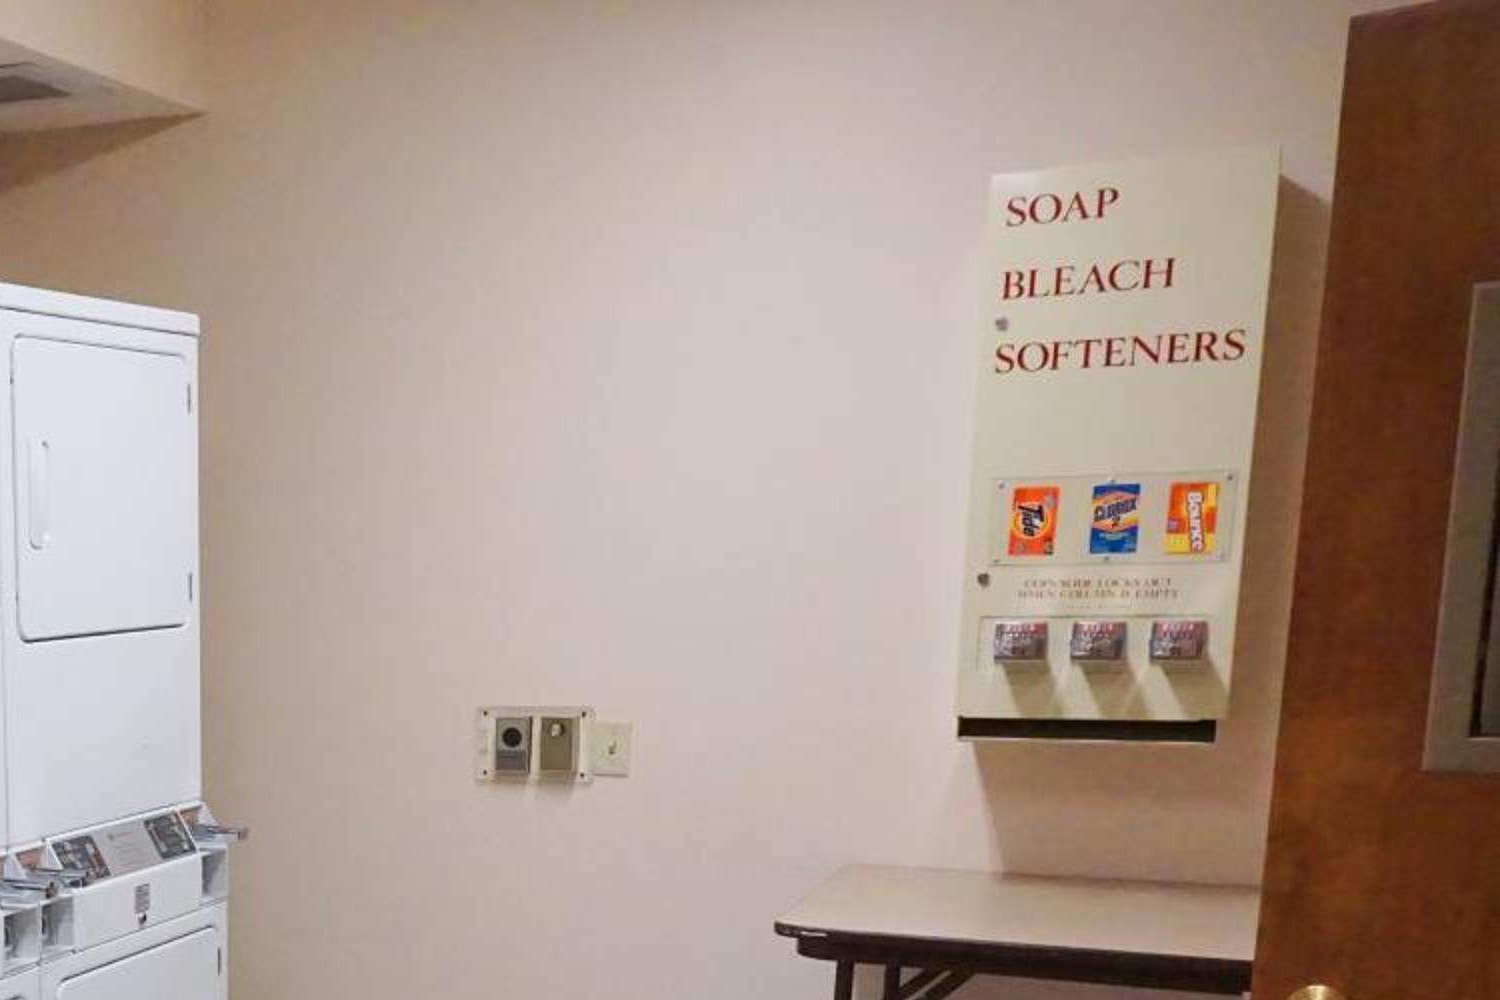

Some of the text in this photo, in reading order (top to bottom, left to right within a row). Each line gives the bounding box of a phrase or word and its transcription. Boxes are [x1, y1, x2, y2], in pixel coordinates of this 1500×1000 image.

[1005, 187, 1120, 227] SOAP
[1002, 257, 1176, 301] BLEACH
[994, 328, 1247, 374] SOFTENERS
[1017, 504, 1045, 537] Tide
[1186, 491, 1205, 551] Bounce
